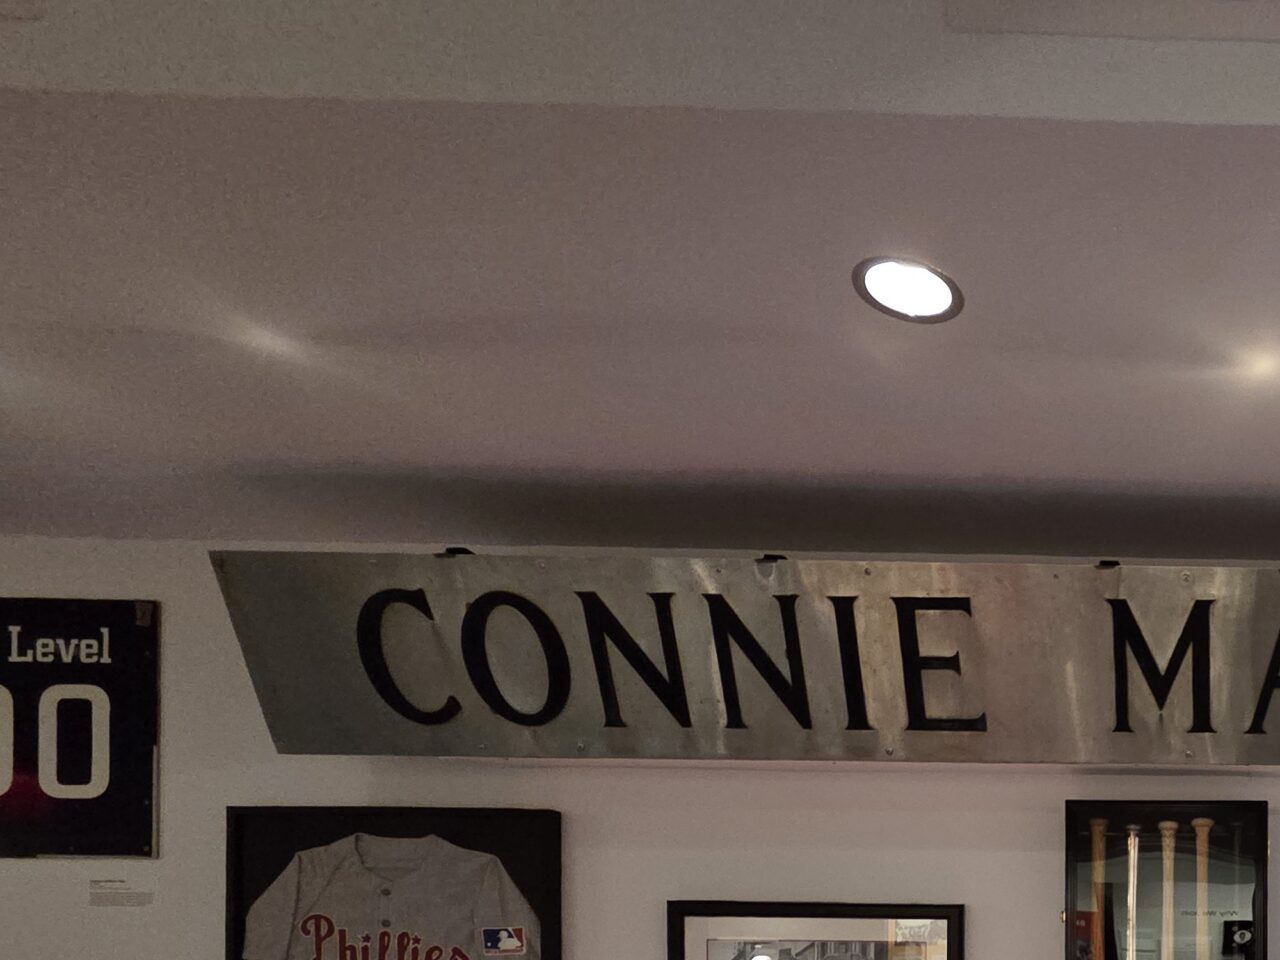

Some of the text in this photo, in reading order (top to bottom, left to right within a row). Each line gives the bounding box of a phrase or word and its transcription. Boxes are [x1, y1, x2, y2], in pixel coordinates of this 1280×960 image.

[7, 625, 112, 664] Level
[356, 587, 988, 731] CONNIE
[0, 683, 111, 800] 0
